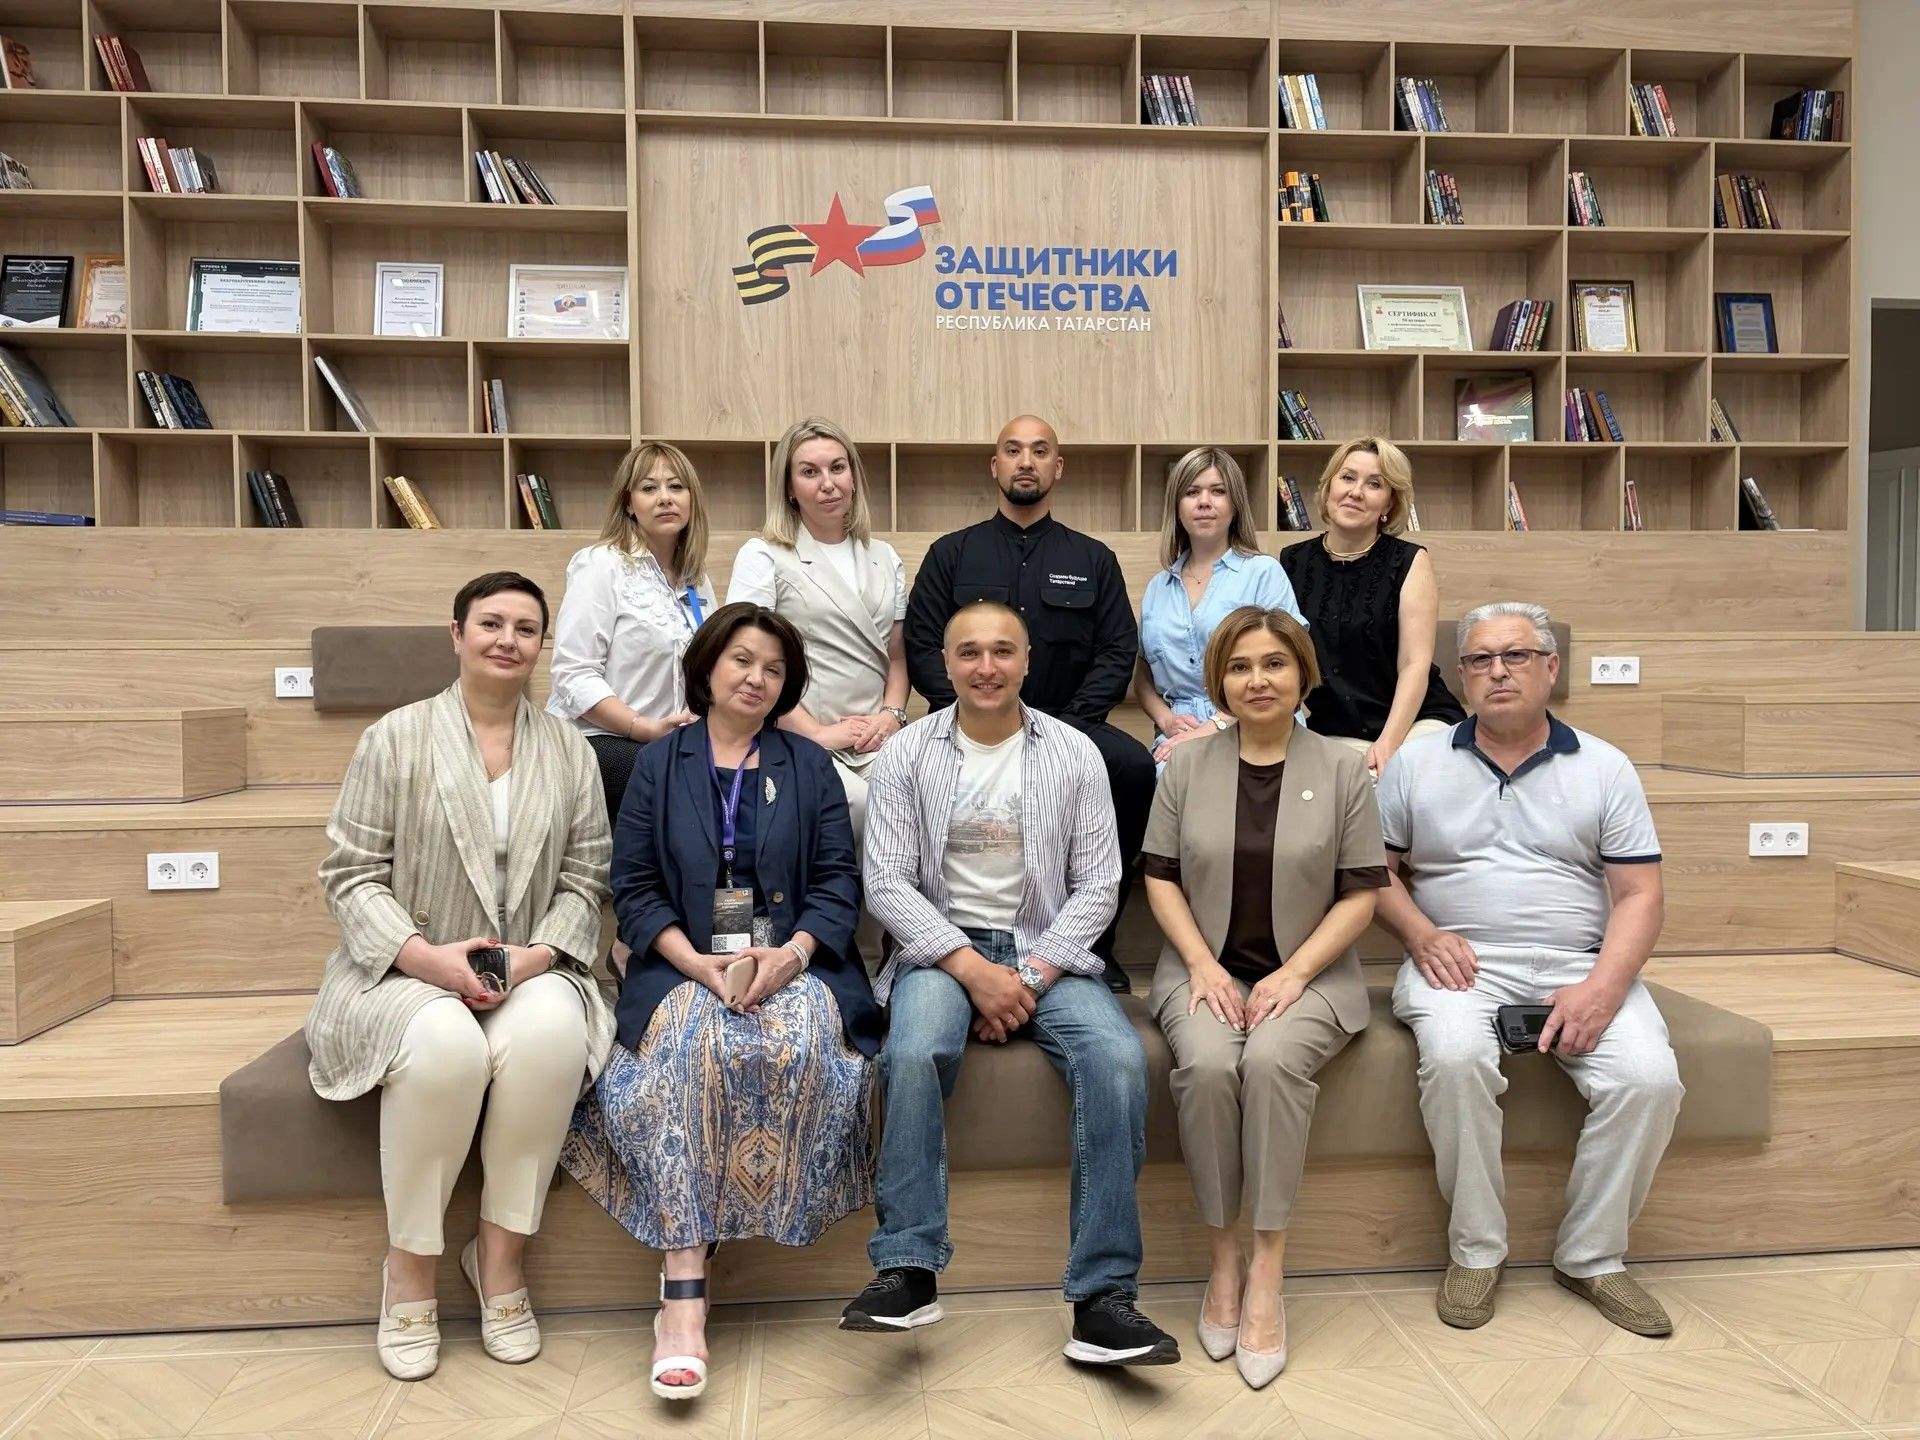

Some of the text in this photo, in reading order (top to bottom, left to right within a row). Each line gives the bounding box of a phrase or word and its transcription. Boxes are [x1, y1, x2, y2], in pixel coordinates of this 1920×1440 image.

[934, 245, 1178, 279] ЗАЩИТНИКИ
[935, 281, 1151, 312] ОТЕЧЕСТВА
[936, 315, 1151, 332] РЕСПУБЛИКА ТАТАРСТАН
